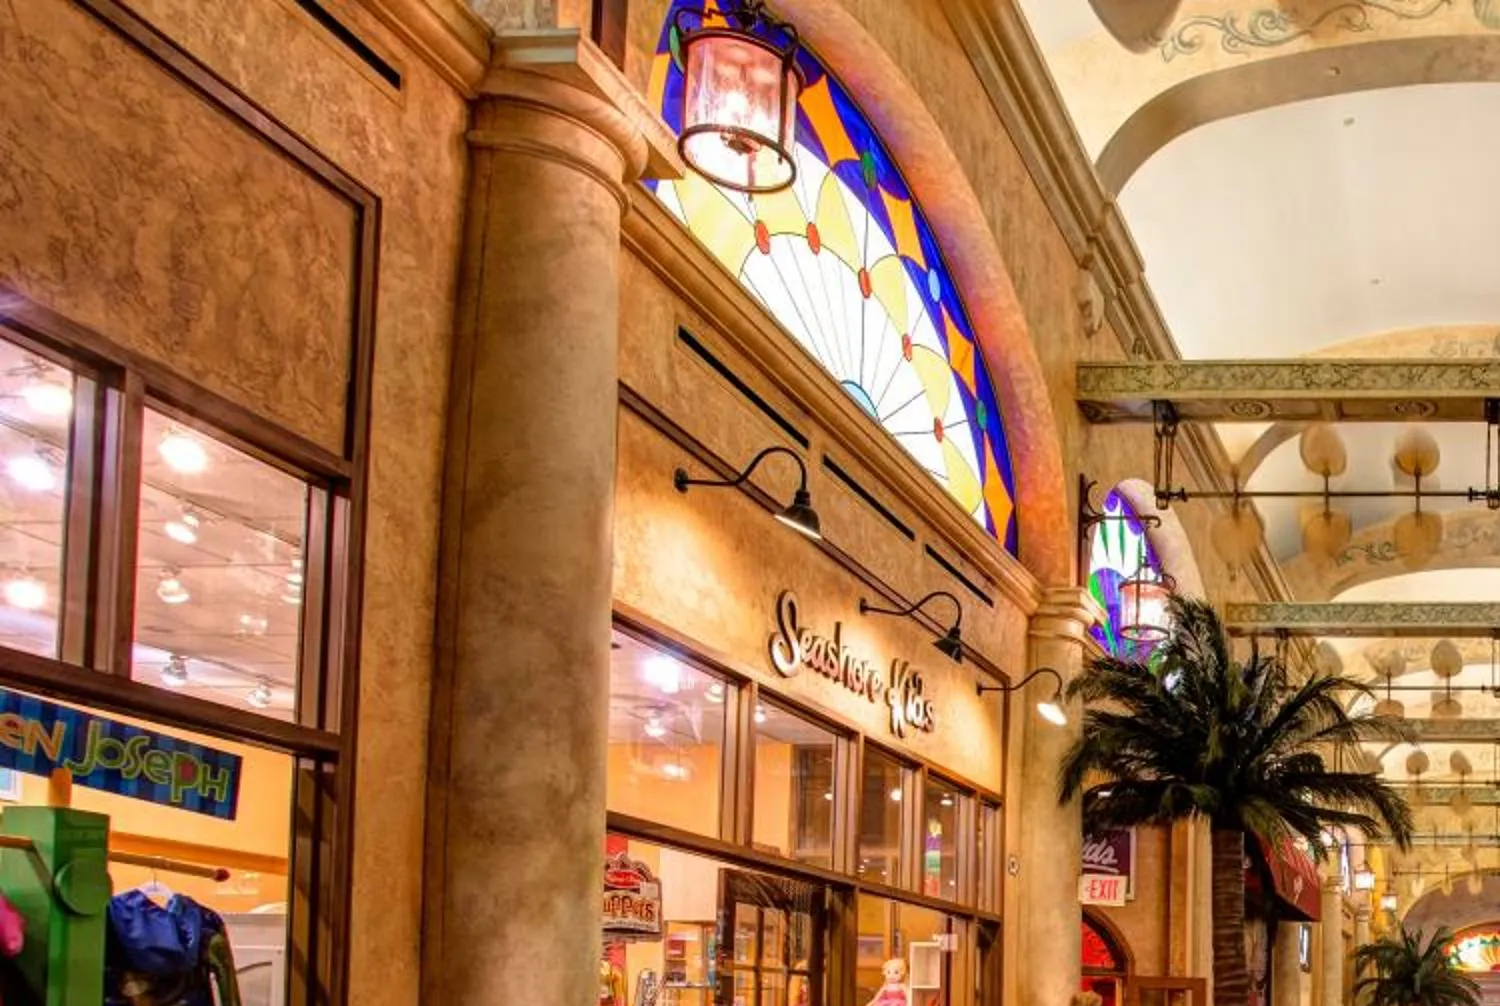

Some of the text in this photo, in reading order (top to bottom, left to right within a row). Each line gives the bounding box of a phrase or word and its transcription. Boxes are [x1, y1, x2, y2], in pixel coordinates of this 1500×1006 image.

[768, 589, 935, 739] Seashore Kids
[1090, 879, 1118, 901] EXIT
